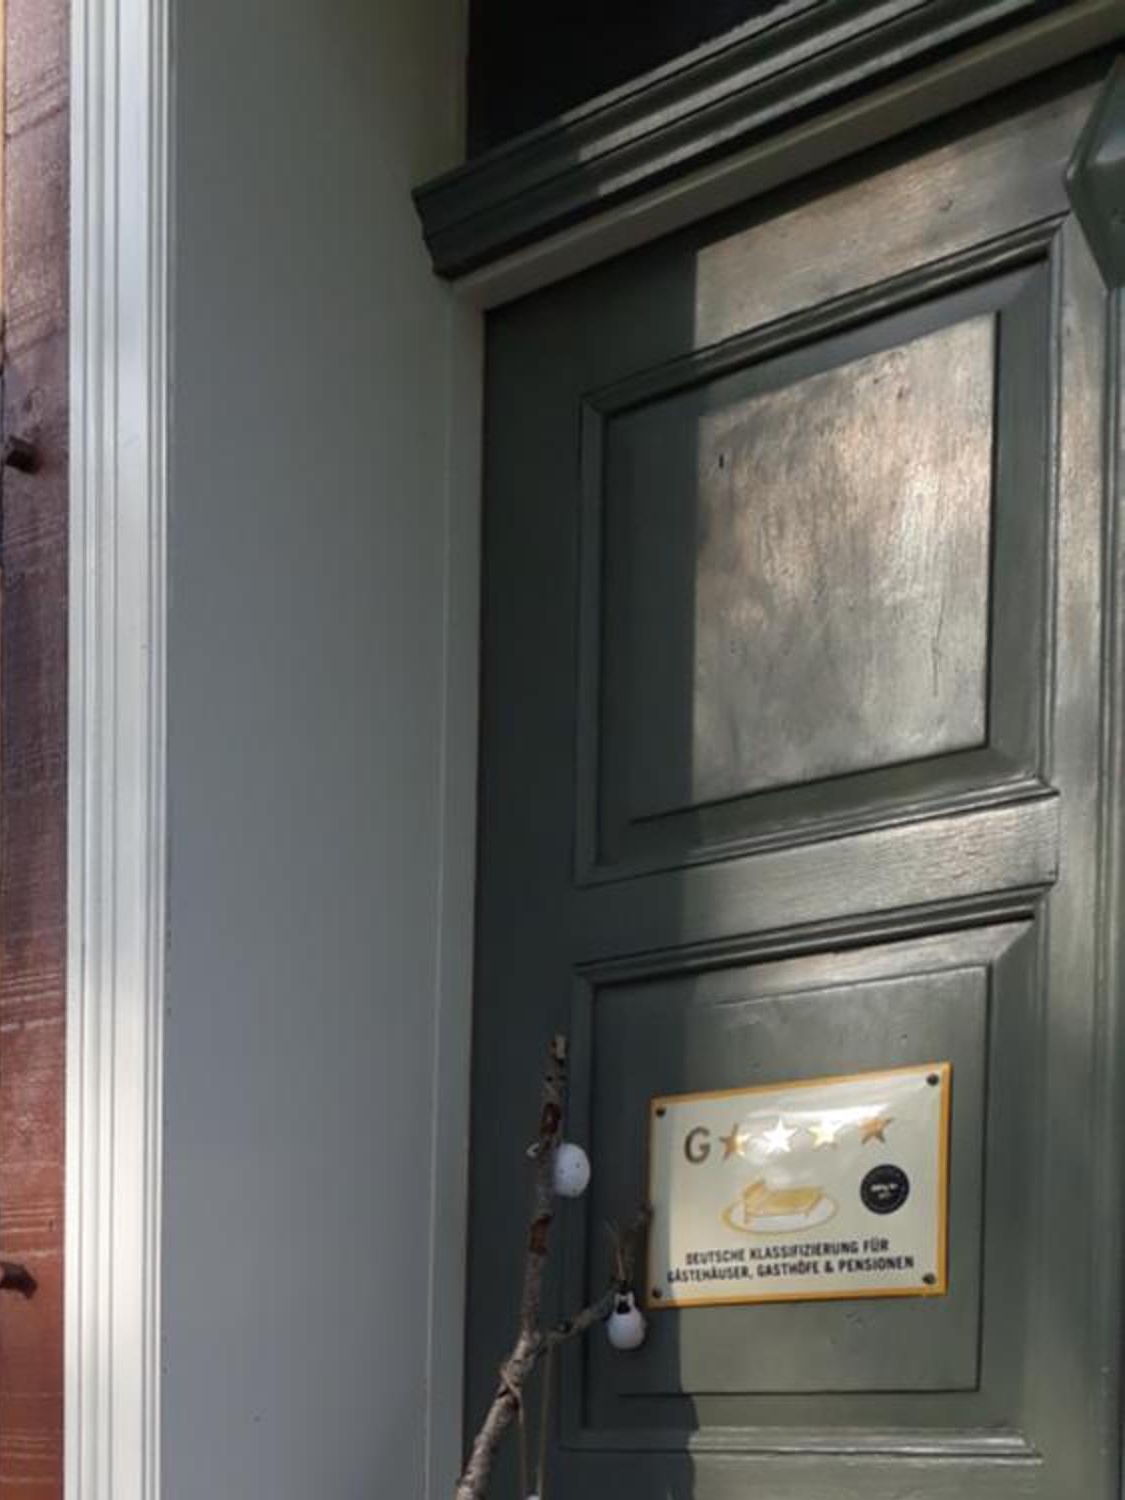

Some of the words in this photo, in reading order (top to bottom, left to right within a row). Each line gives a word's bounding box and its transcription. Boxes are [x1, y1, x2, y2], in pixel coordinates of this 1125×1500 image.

[684, 1126, 712, 1164] G
[685, 1248, 746, 1266] DEUTSCHE
[748, 1239, 859, 1259] KLASSIFIZIERUNG
[862, 1237, 890, 1253] FÜR
[756, 1259, 820, 1278] GASTHÖFE
[837, 1255, 915, 1273] PENSIONEN
